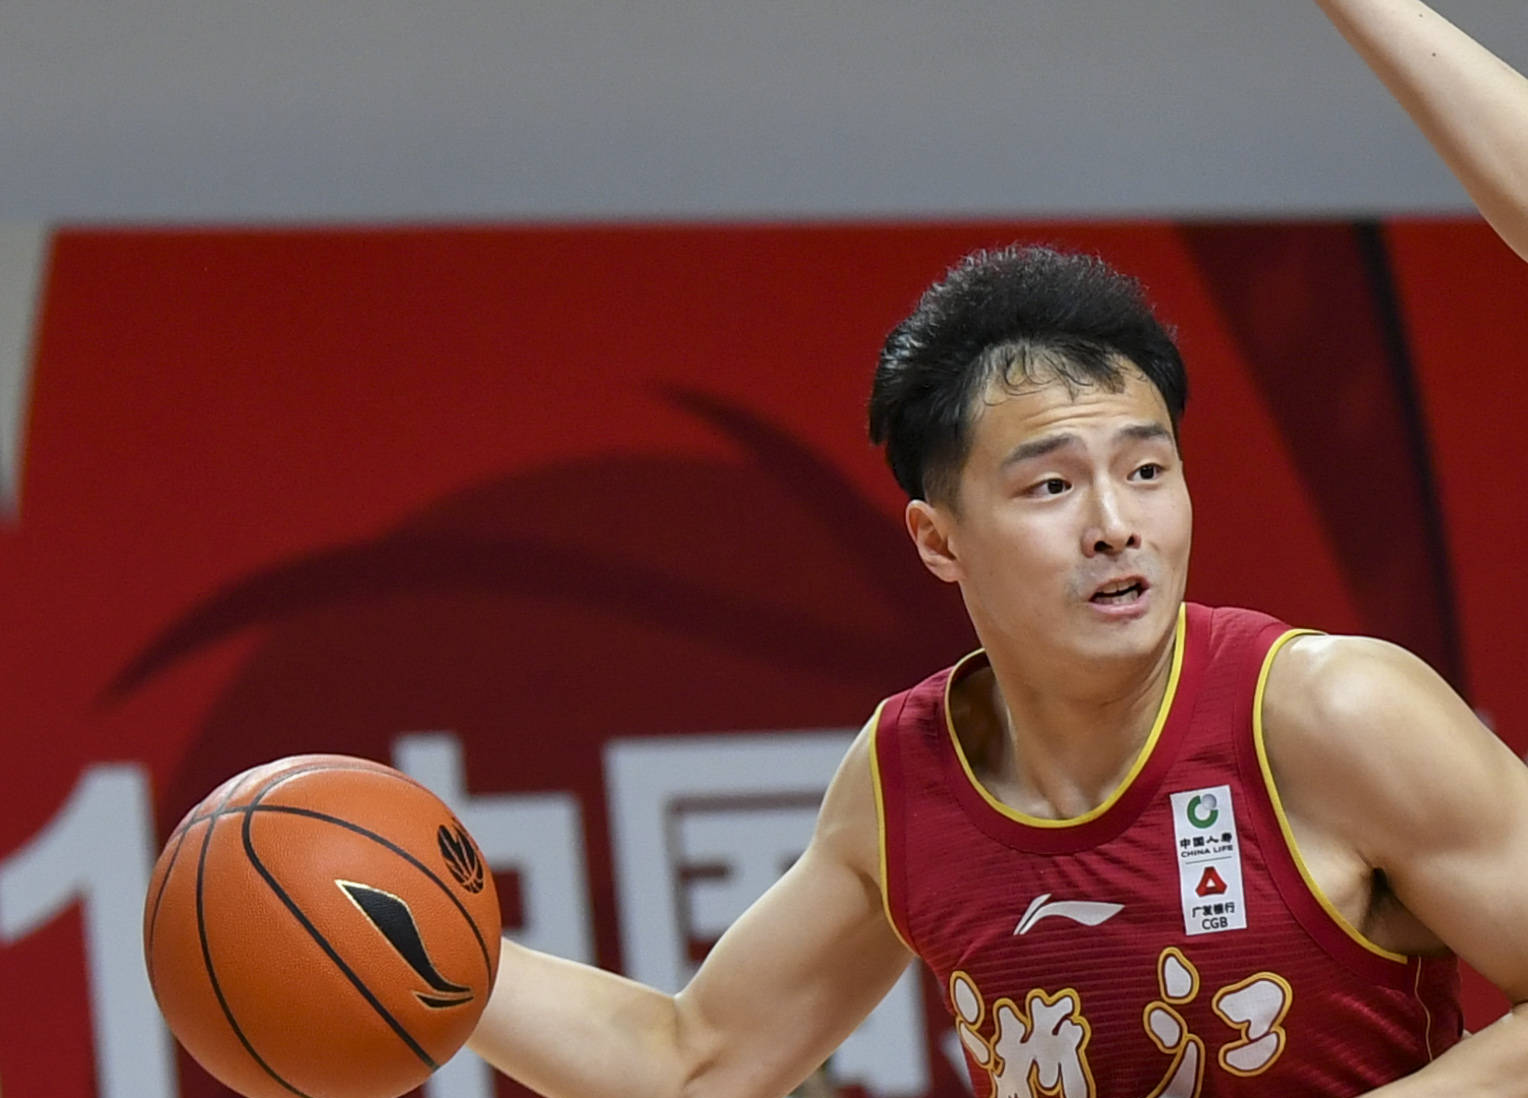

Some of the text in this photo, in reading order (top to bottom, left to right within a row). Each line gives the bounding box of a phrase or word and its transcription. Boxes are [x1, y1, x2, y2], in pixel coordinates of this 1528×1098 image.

[1180, 844, 1233, 858] CHINA LIFE
[1192, 901, 1235, 918] 广发银行
[1201, 916, 1229, 930] CGB
